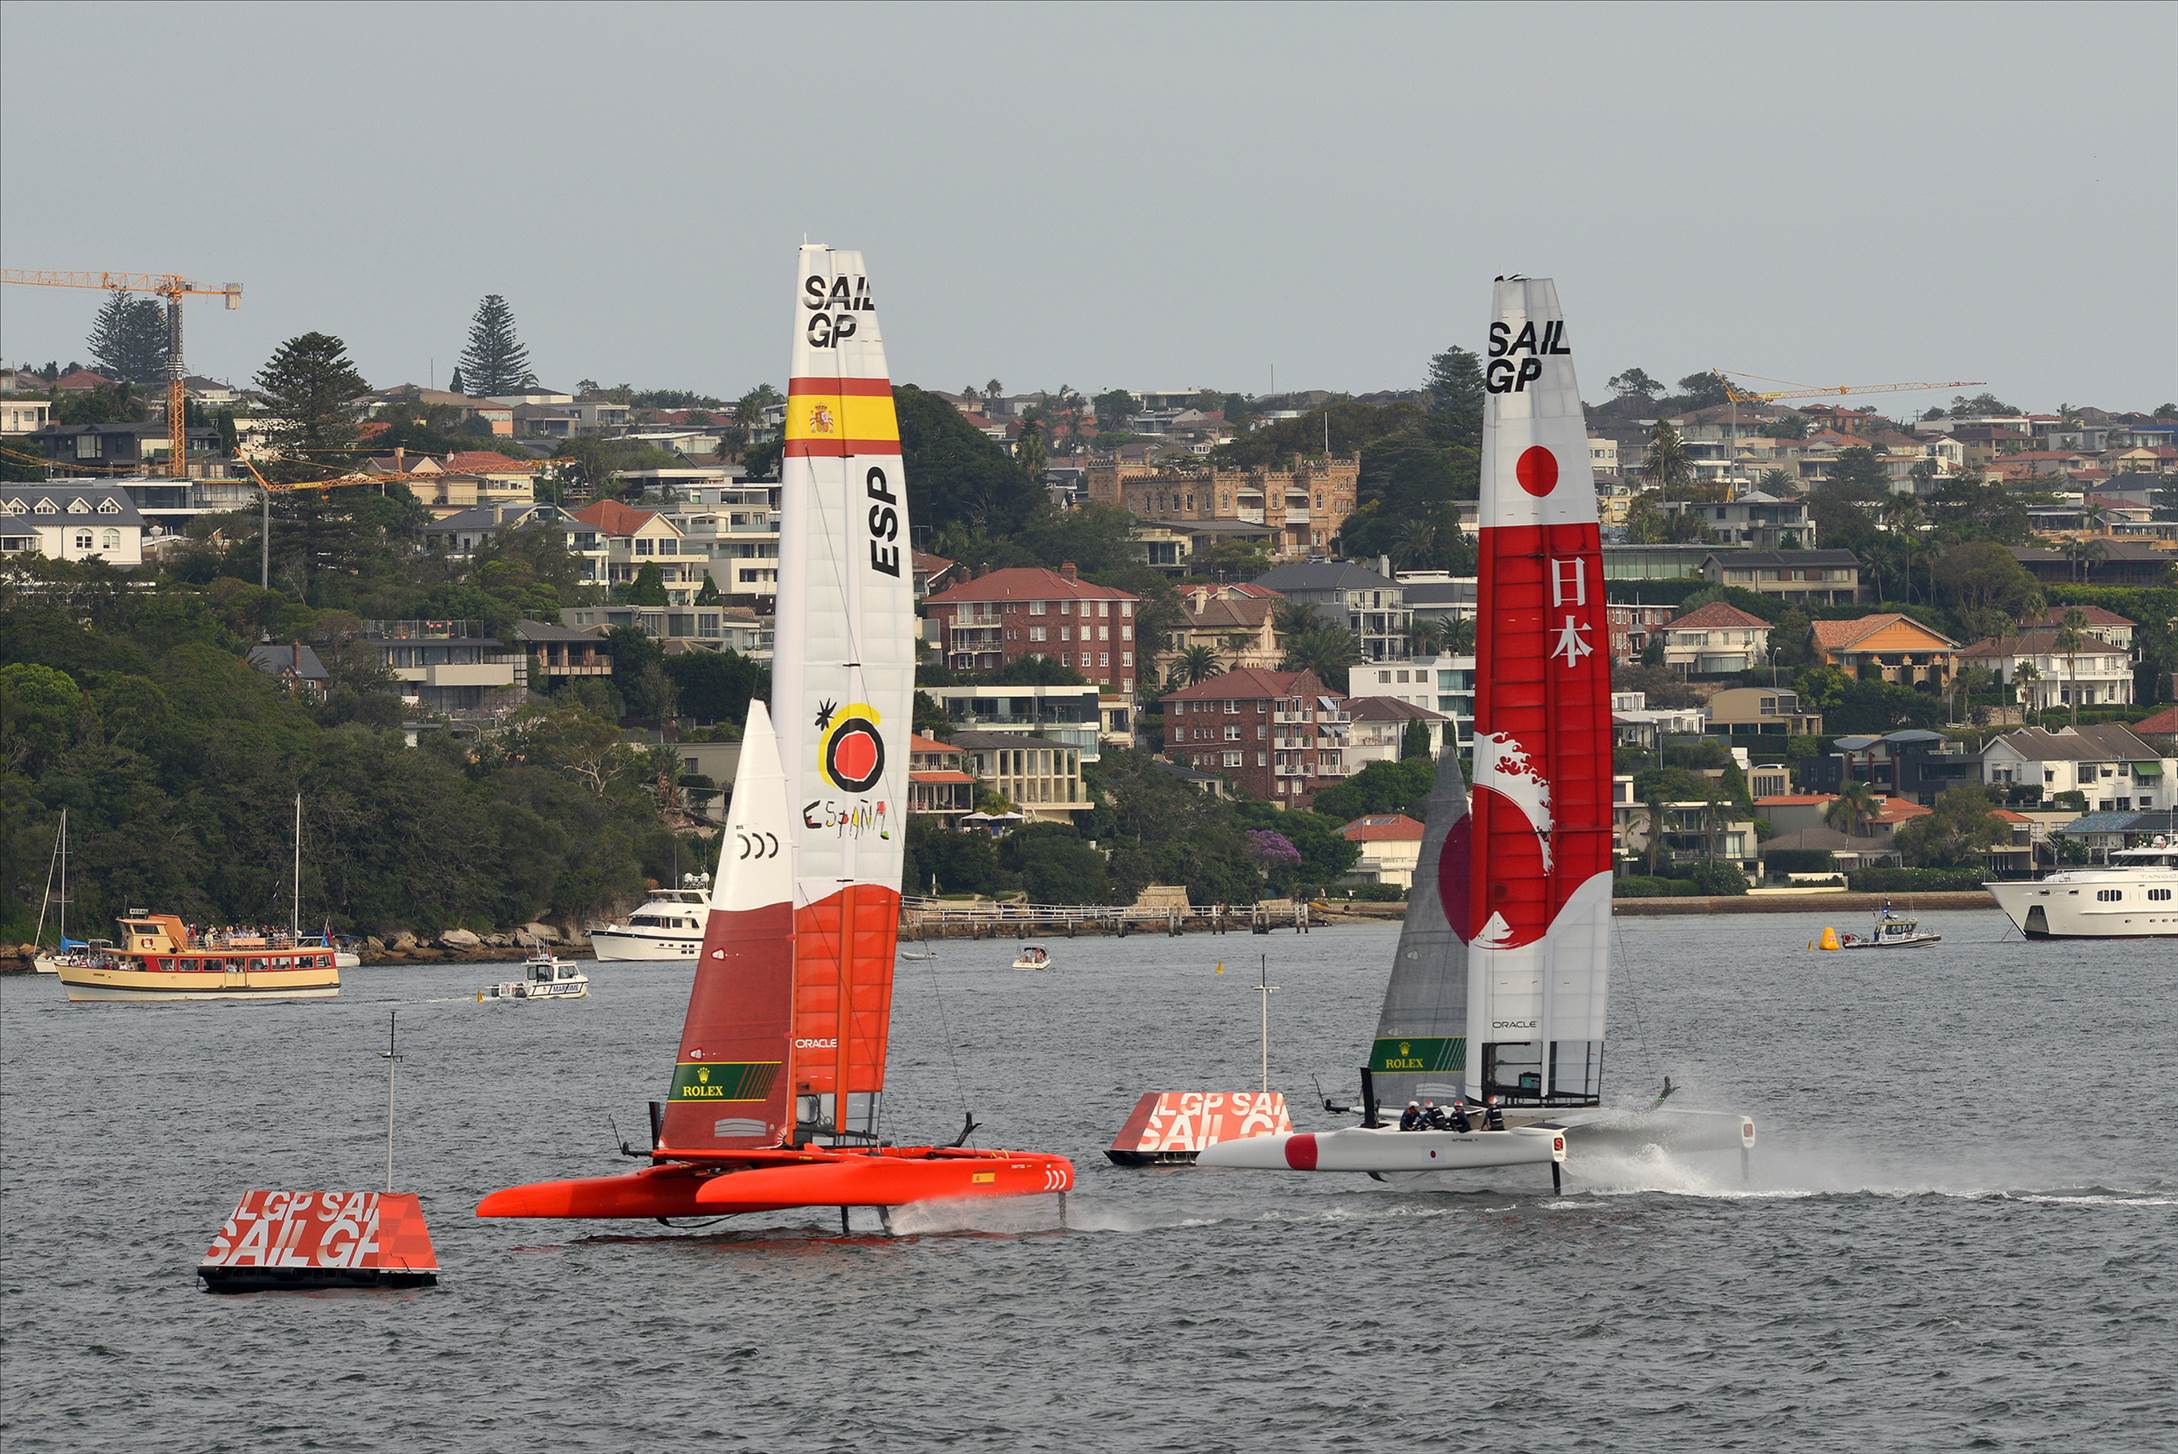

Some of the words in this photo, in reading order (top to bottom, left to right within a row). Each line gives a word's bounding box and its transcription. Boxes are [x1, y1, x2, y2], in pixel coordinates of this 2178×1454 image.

[802, 275, 875, 311] SAIL
[807, 312, 857, 349] GP
[1488, 320, 1571, 357] SAIL
[1486, 358, 1543, 394] GP
[866, 466, 901, 578] ESP
[1549, 556, 1594, 668] 日本
[1492, 1020, 1537, 1029] ORACLE
[795, 1038, 838, 1049] ORACLE
[1385, 1058, 1424, 1069] ROLEX
[682, 1085, 724, 1097] ROLEX
[1180, 1092, 1224, 1117] GP
[262, 1190, 313, 1221] GP
